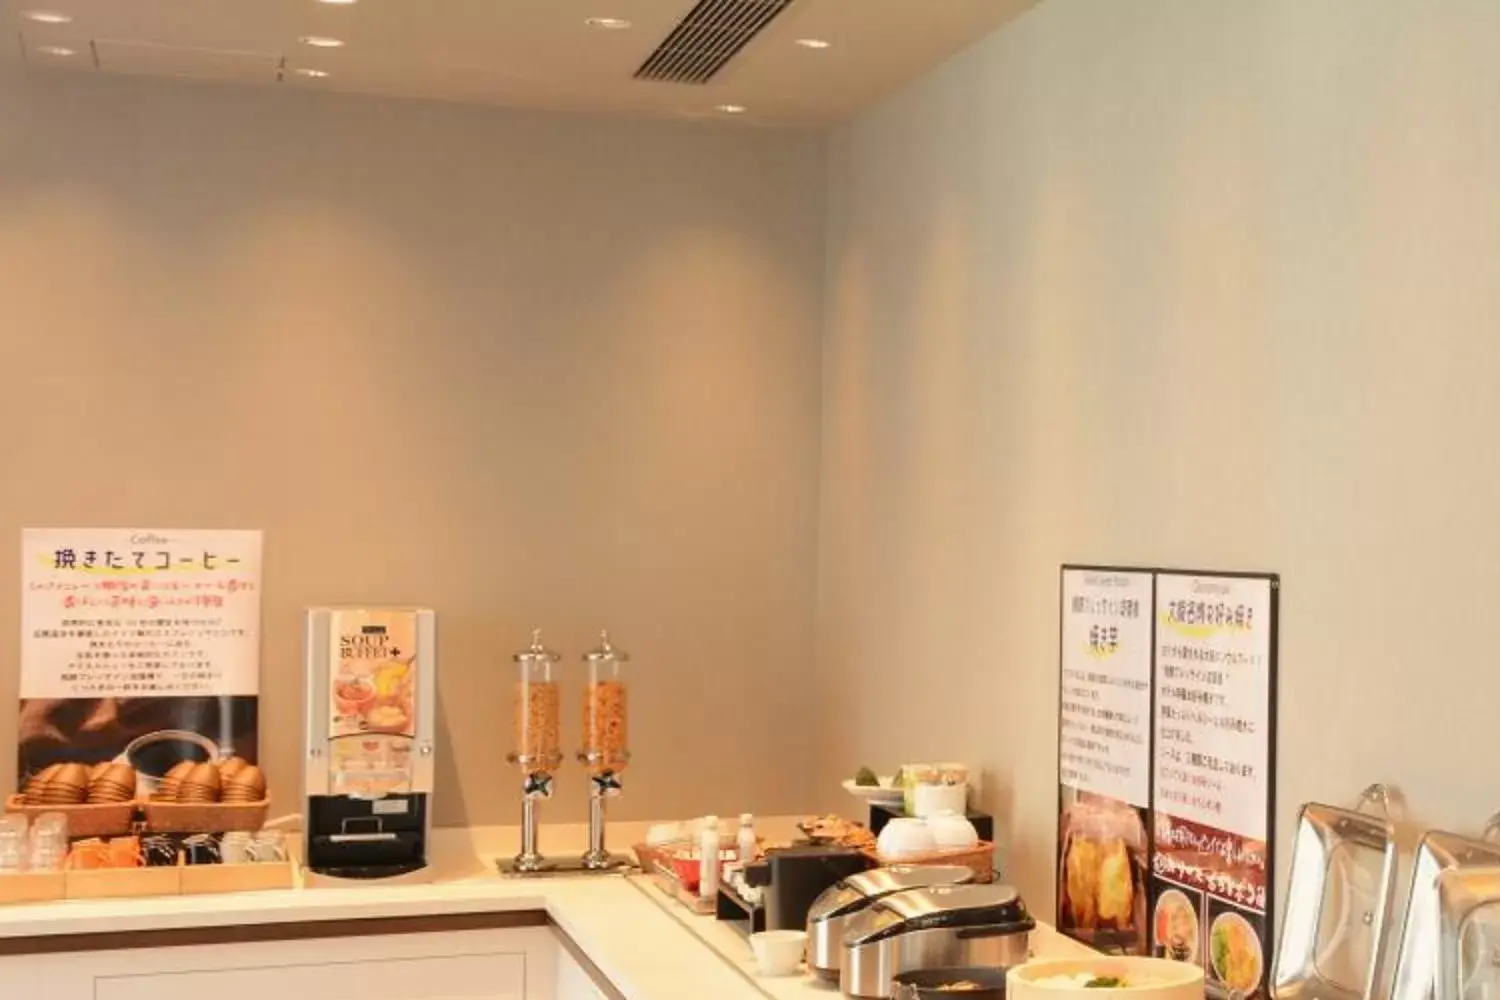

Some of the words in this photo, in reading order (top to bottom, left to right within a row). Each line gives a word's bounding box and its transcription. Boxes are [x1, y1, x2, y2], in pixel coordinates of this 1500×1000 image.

[54, 548, 241, 570] 挽きたてコーヒー
[340, 635, 389, 646] SOUP
